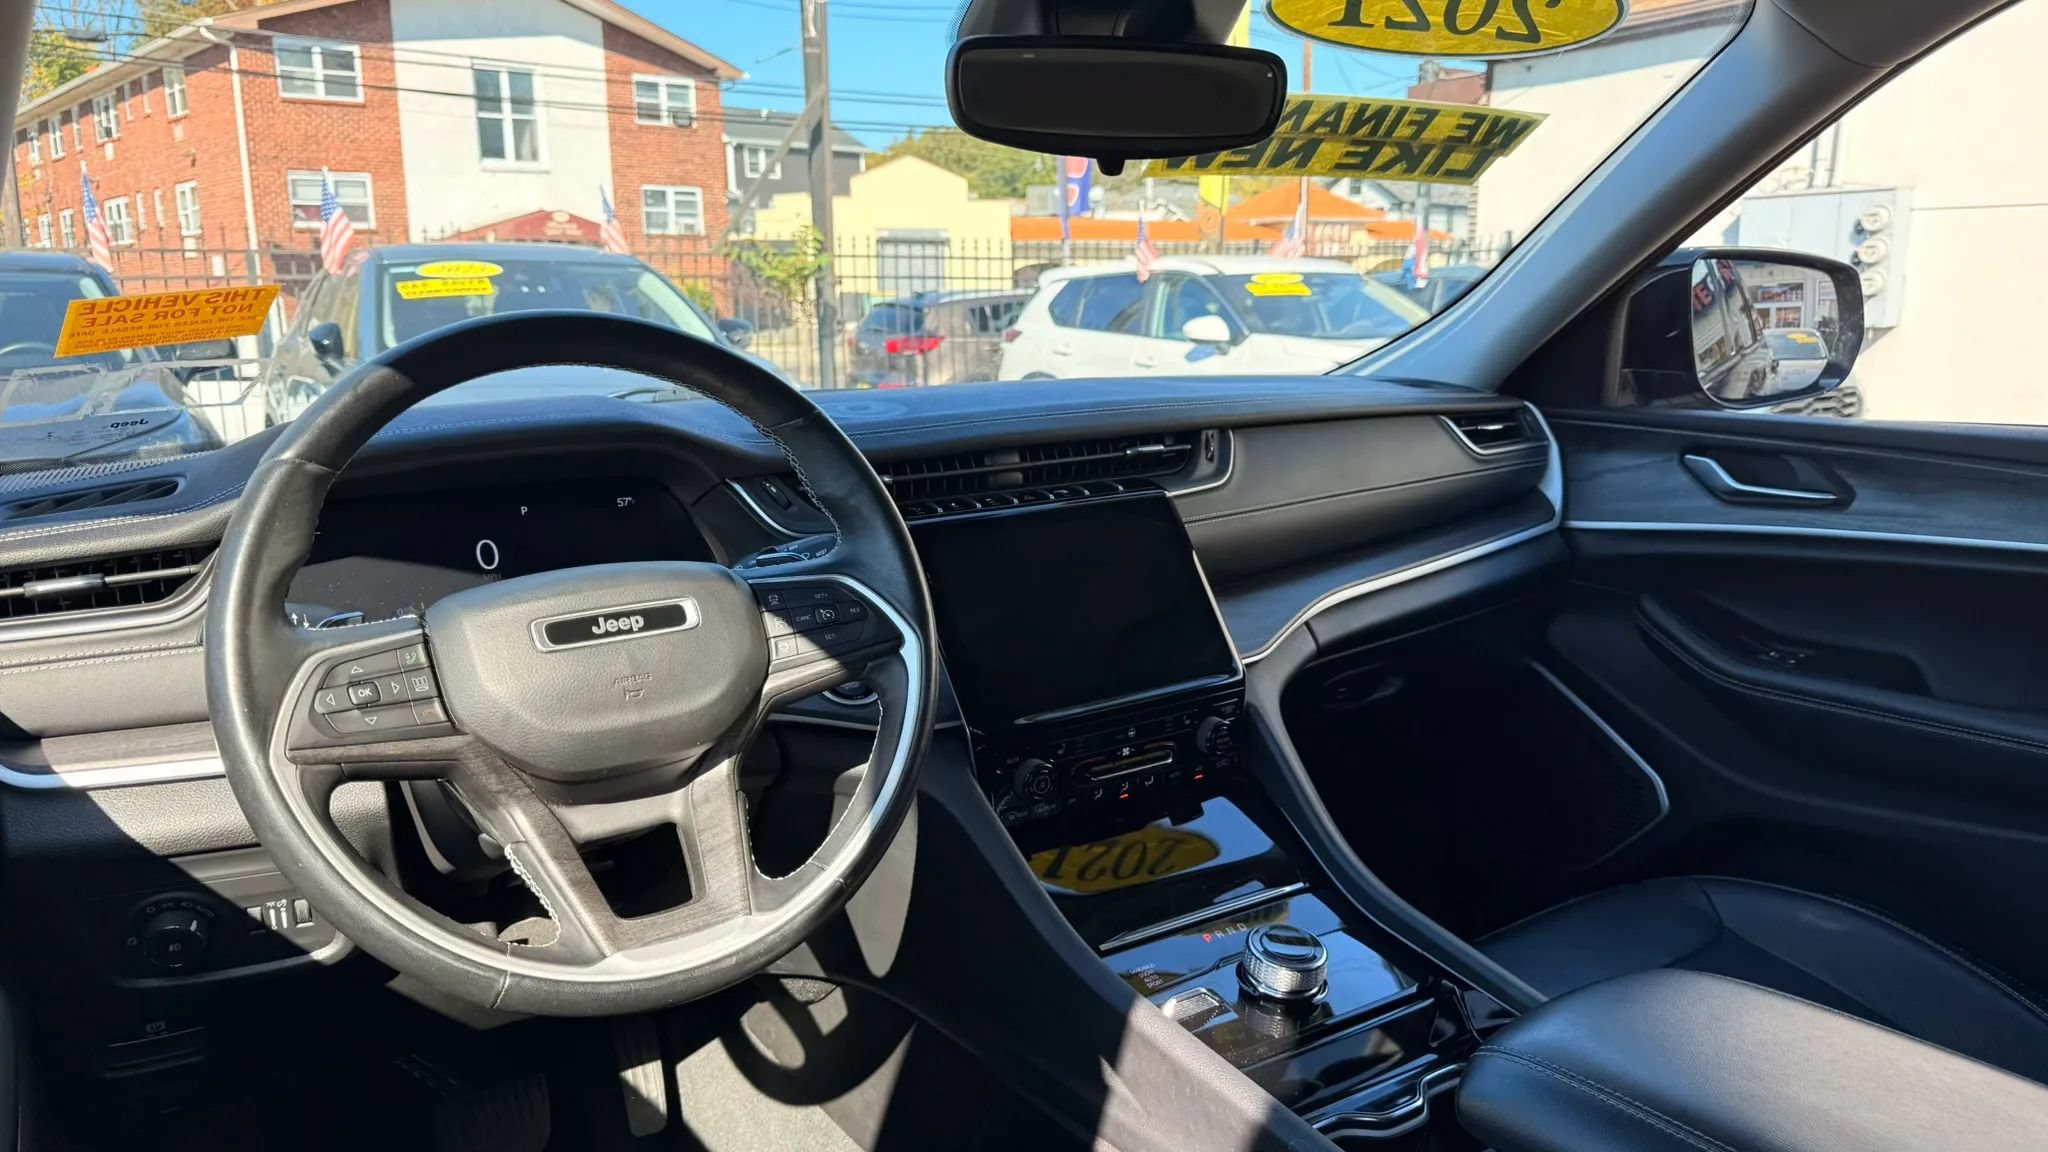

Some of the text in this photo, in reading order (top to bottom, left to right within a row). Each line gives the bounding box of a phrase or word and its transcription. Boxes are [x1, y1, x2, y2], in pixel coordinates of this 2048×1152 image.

[521, 506, 528, 516] P
[476, 539, 499, 570] 0
[592, 615, 644, 635] Jeep
[358, 688, 372, 697] OK
[1203, 922, 1248, 943] P R N D
